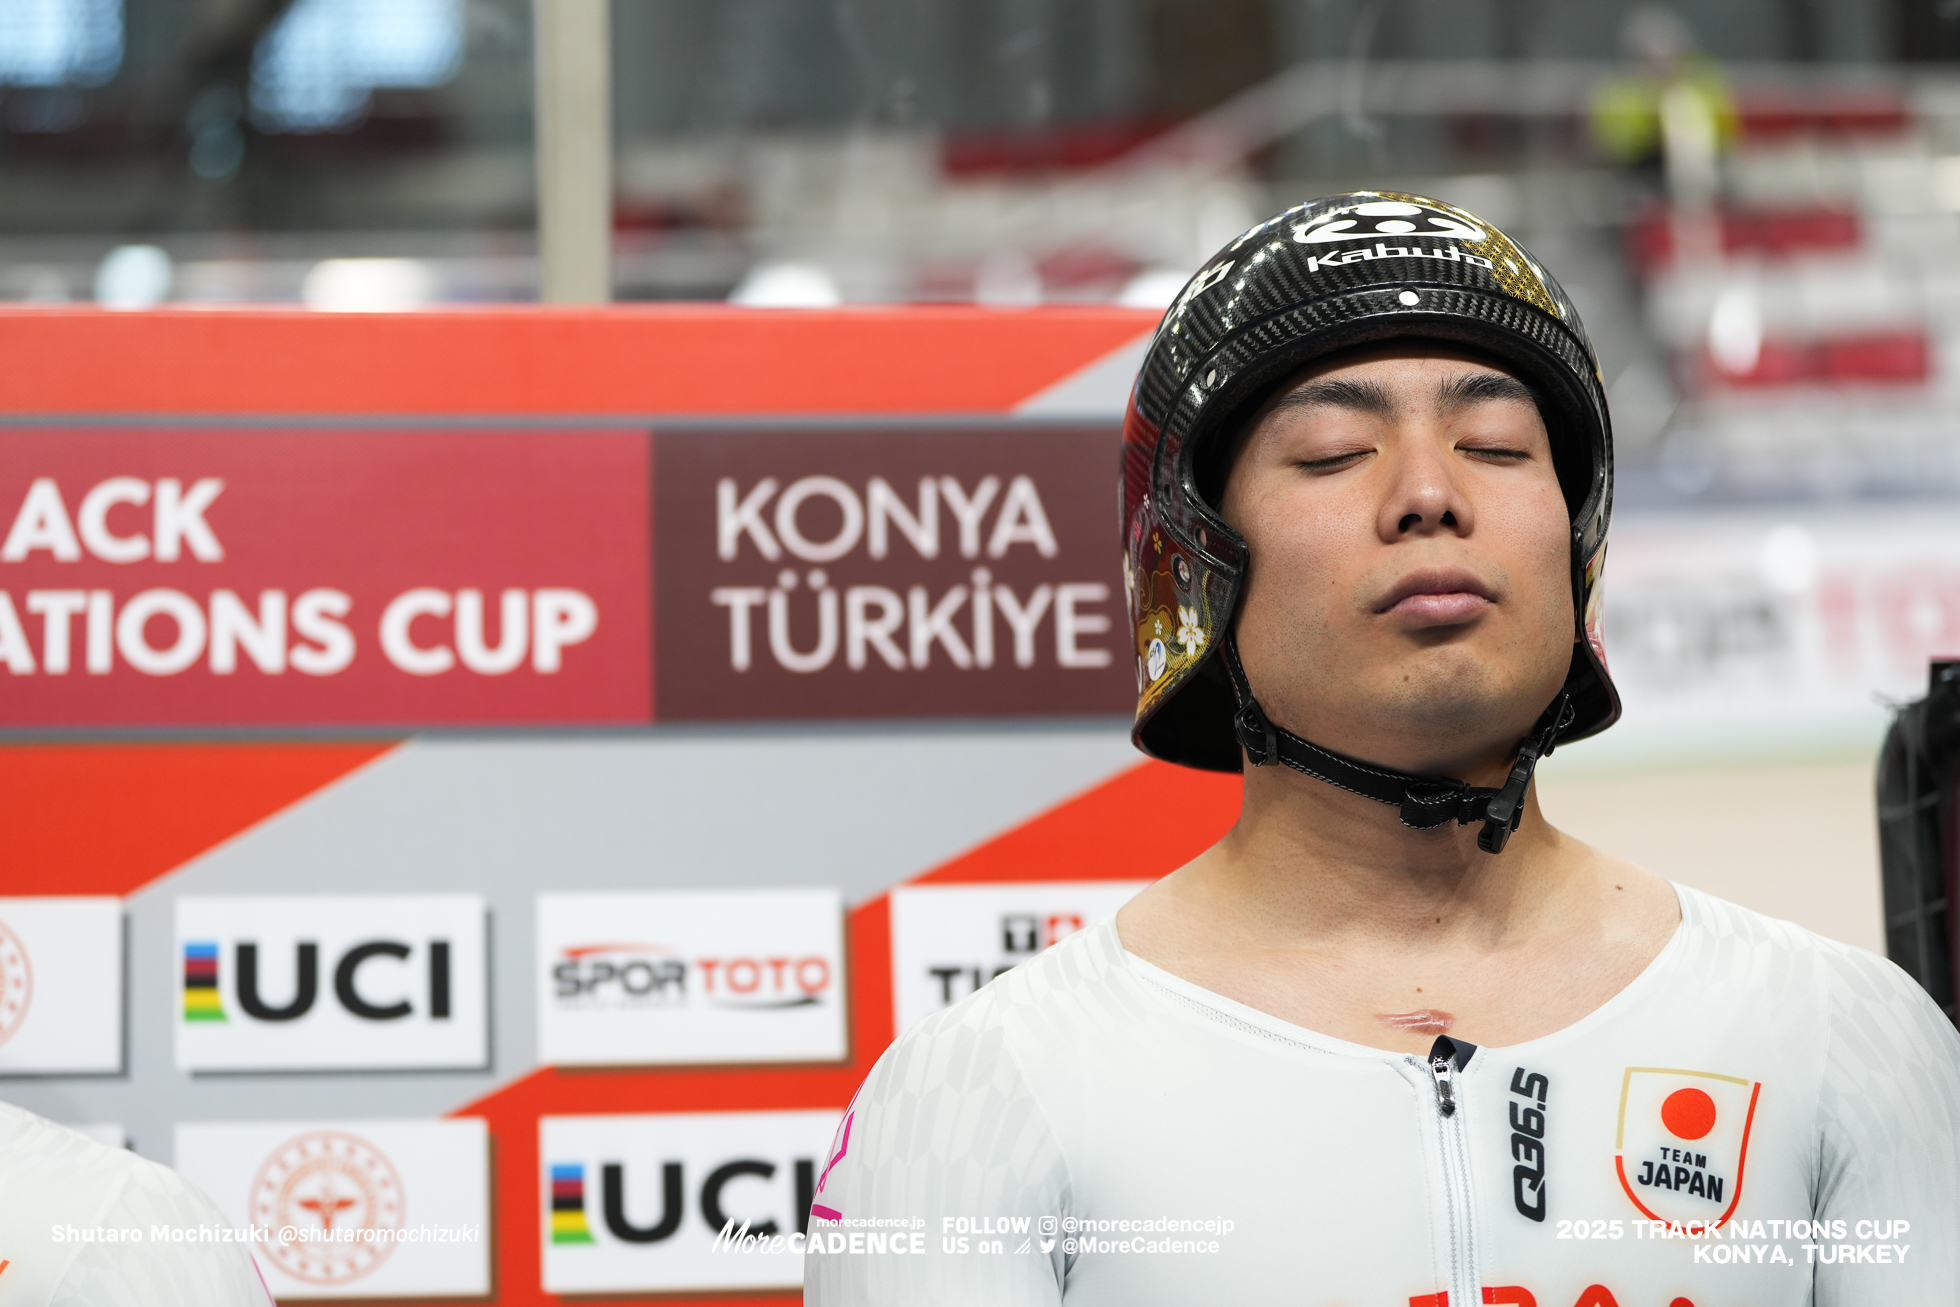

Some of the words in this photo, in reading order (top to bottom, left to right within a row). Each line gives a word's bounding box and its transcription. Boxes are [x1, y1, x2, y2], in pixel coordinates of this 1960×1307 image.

[1307, 243, 1494, 273] Kabuto
[716, 475, 1058, 562] KONYA
[379, 587, 600, 675] CUP
[711, 567, 1113, 673] TÜRKİYE
[234, 940, 453, 1022] UCI
[1509, 1066, 1549, 1223] Q36.5
[1637, 1160, 1724, 1203] JAPAN
[1660, 1147, 1707, 1169] TEAM
[601, 1157, 816, 1245] UCI
